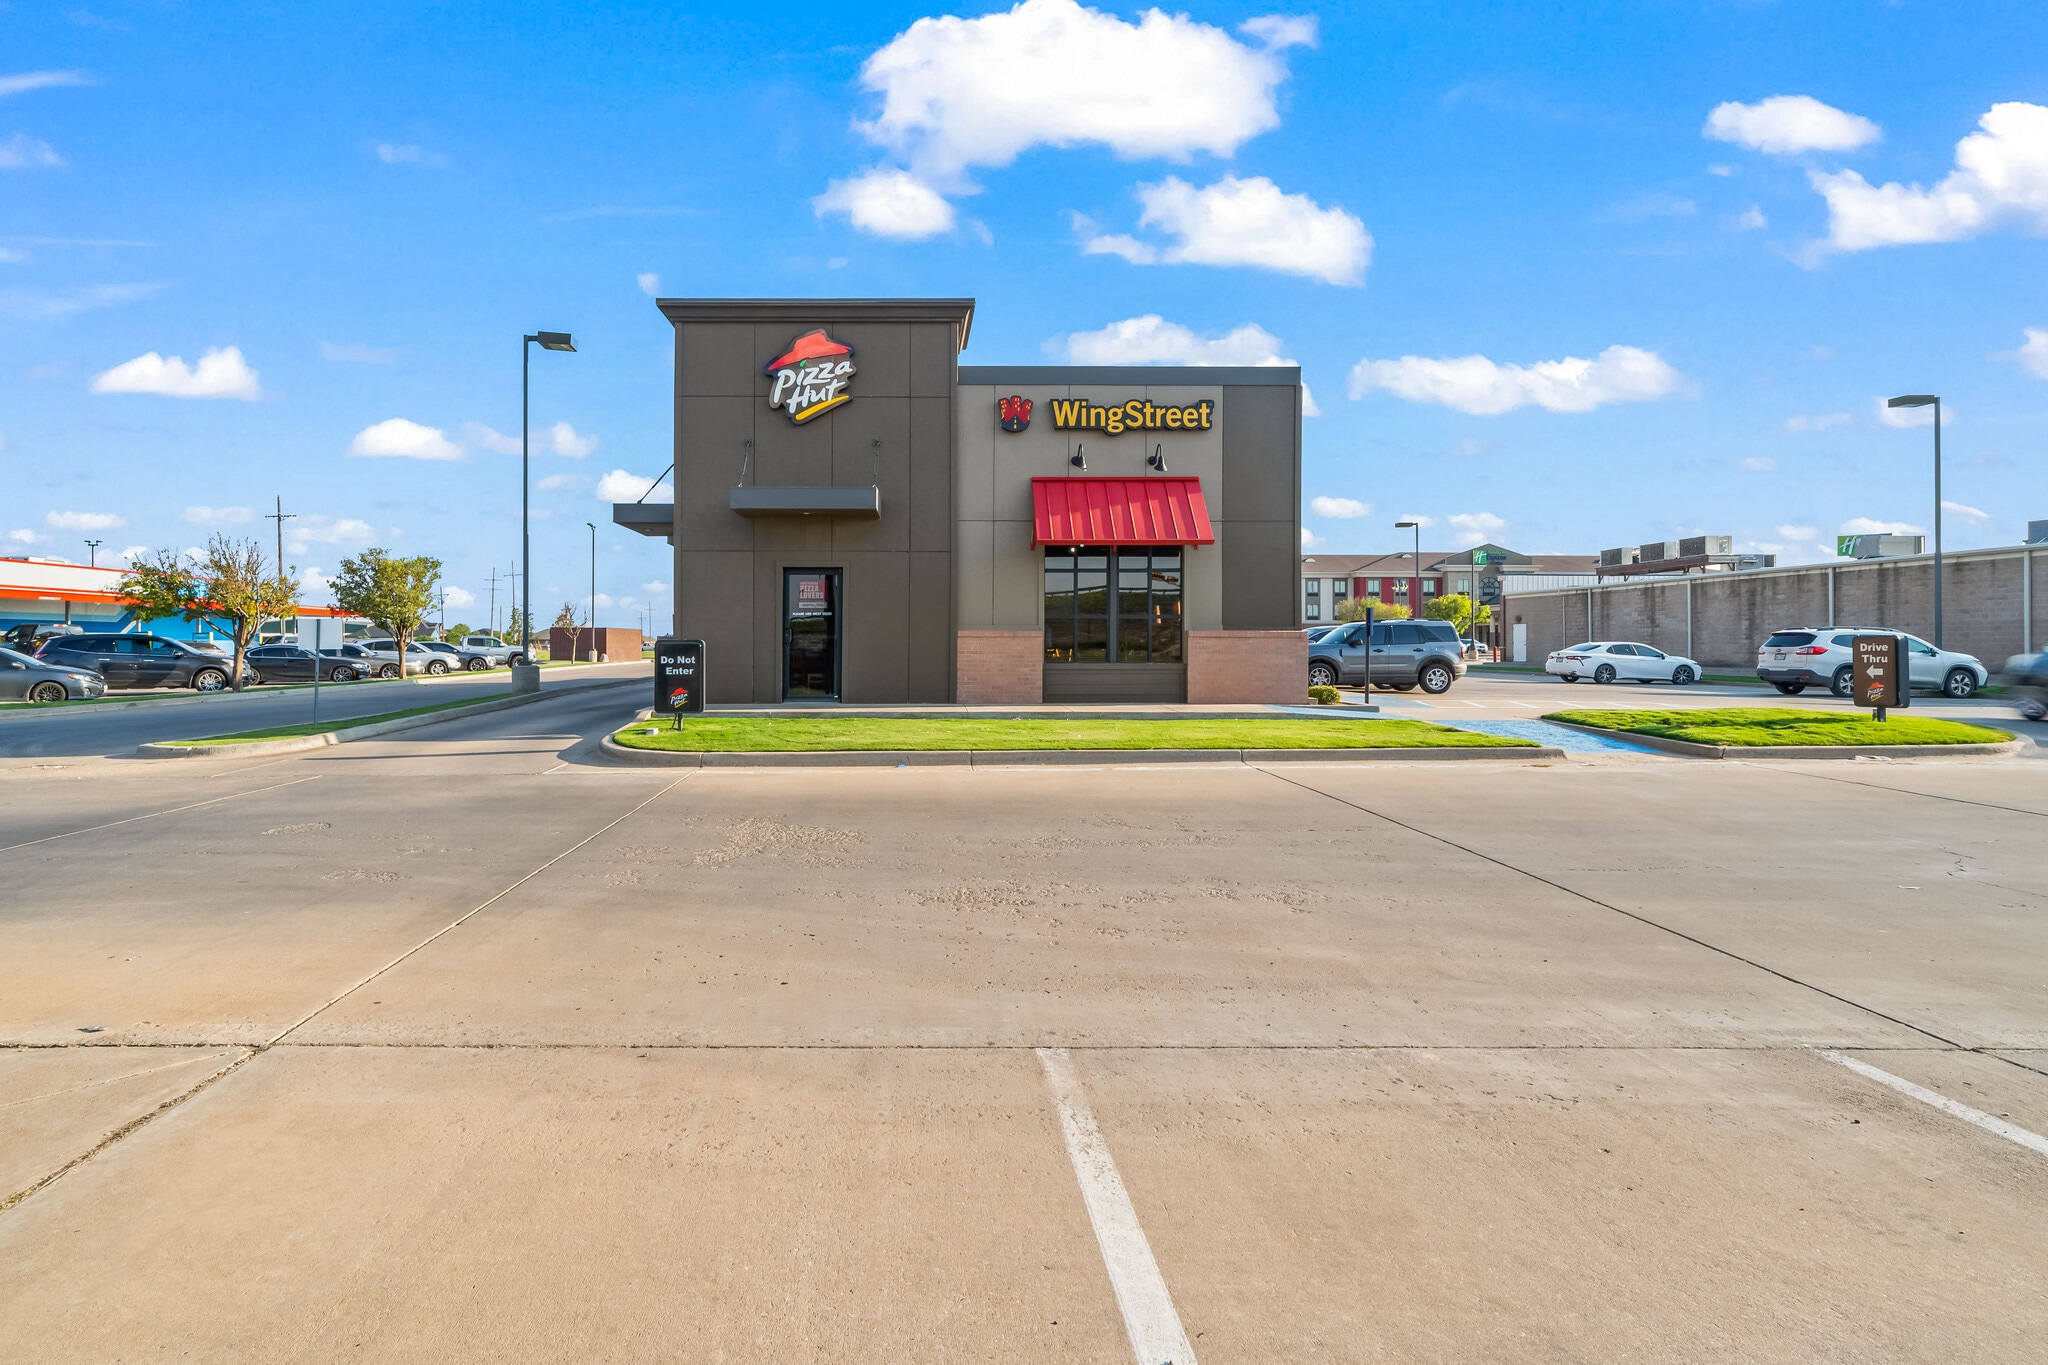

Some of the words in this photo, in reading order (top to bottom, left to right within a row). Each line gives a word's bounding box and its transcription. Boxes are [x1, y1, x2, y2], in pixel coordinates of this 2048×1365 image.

[773, 360, 853, 404] Pizza
[786, 378, 846, 414] Hut
[1052, 400, 1211, 434] WingStreet
[1859, 643, 1889, 652] Drive
[660, 656, 675, 664] Do
[677, 656, 696, 664] Not
[1861, 654, 1888, 663] Thru
[665, 667, 695, 675] Enter
